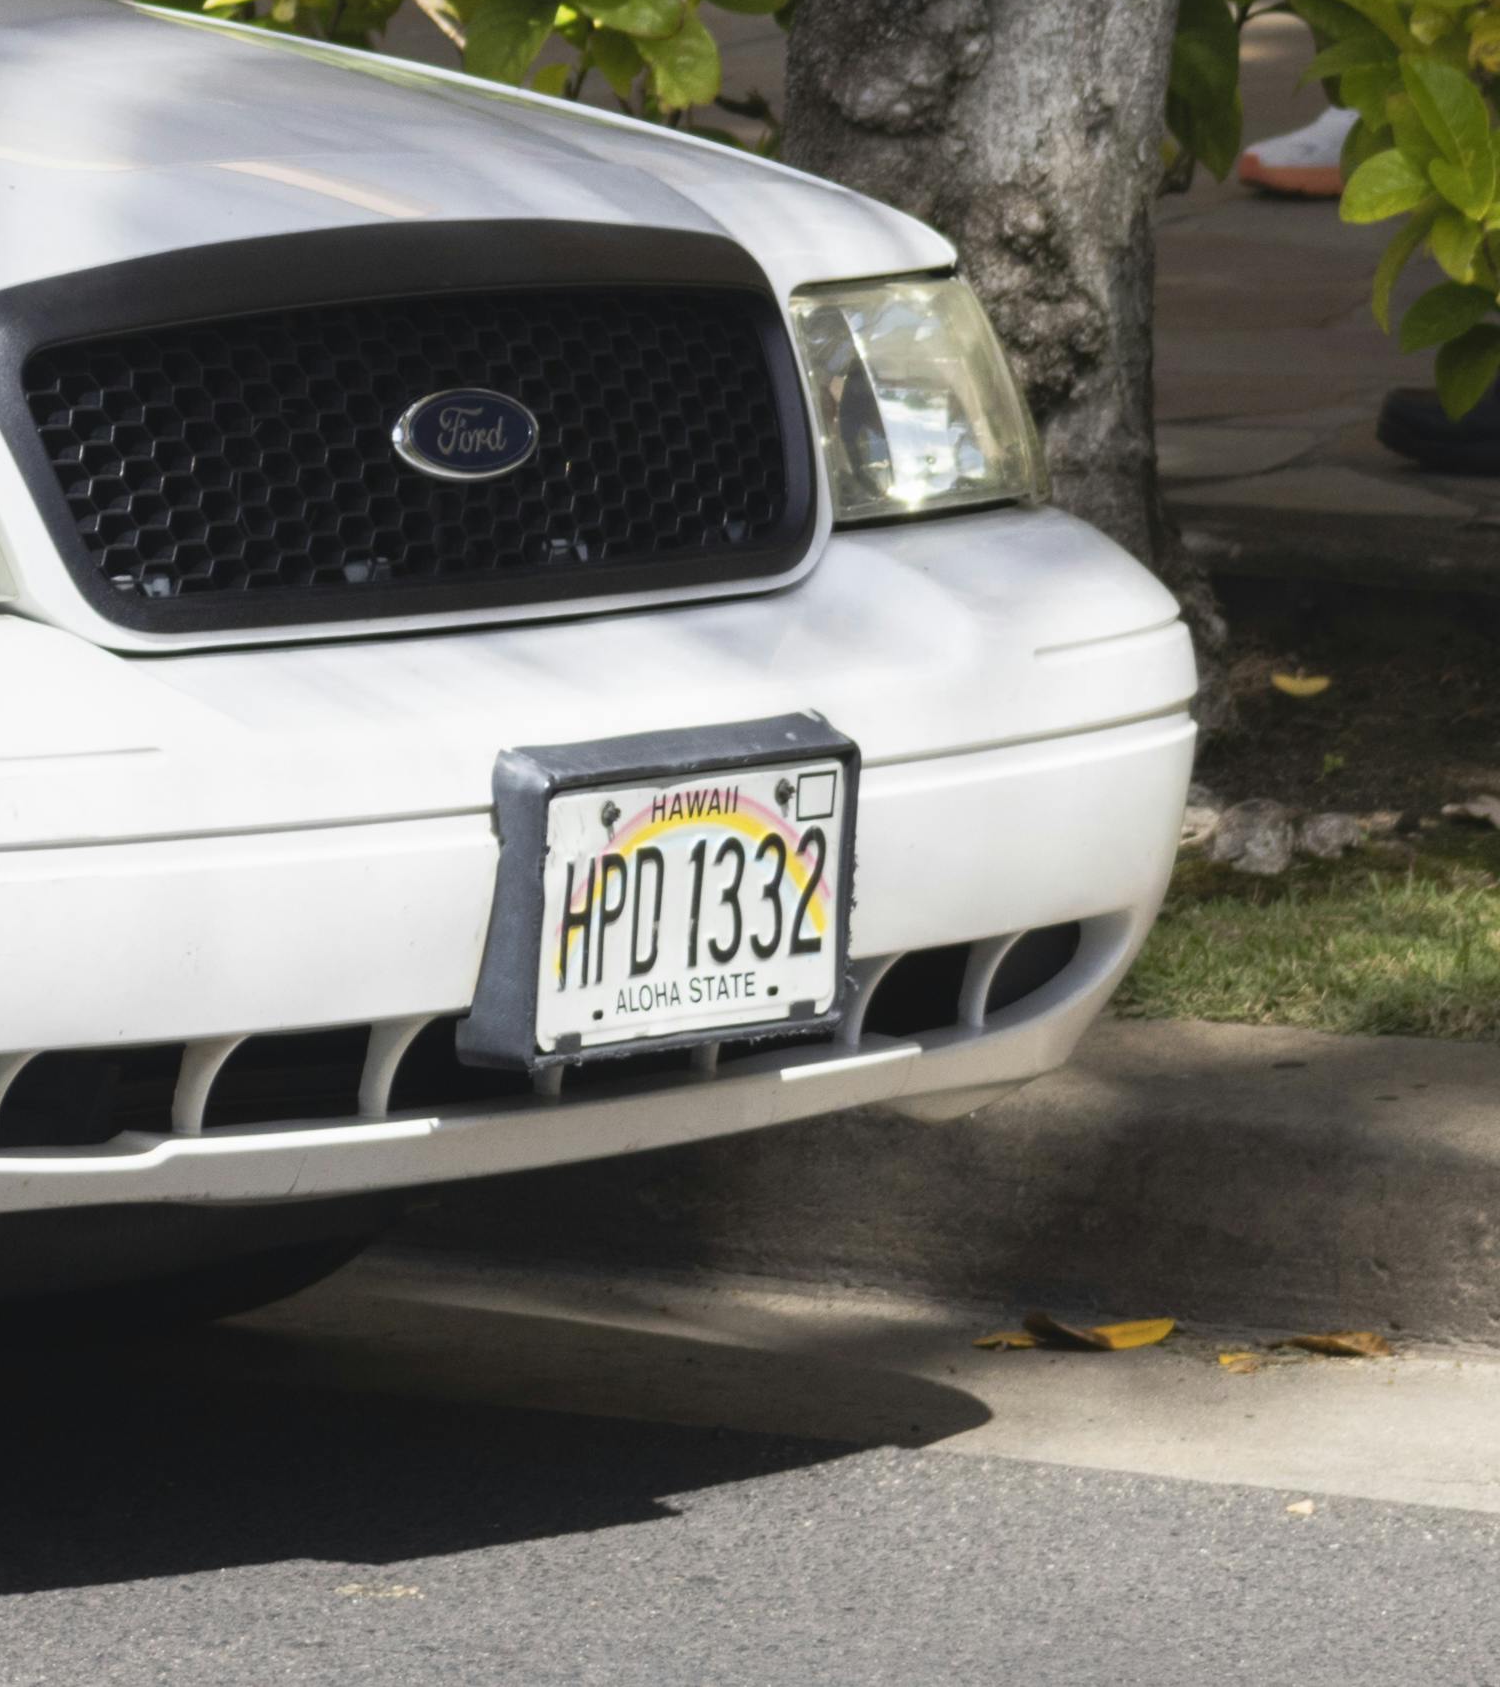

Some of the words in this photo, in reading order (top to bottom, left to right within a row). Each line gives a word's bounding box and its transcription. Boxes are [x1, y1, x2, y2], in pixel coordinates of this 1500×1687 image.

[437, 406, 507, 455] Ford
[651, 786, 740, 823] HAWAII
[557, 846, 665, 990] HPD
[687, 826, 827, 969] 1332
[615, 979, 682, 1015] ALOHA
[690, 972, 757, 1003] STATE
